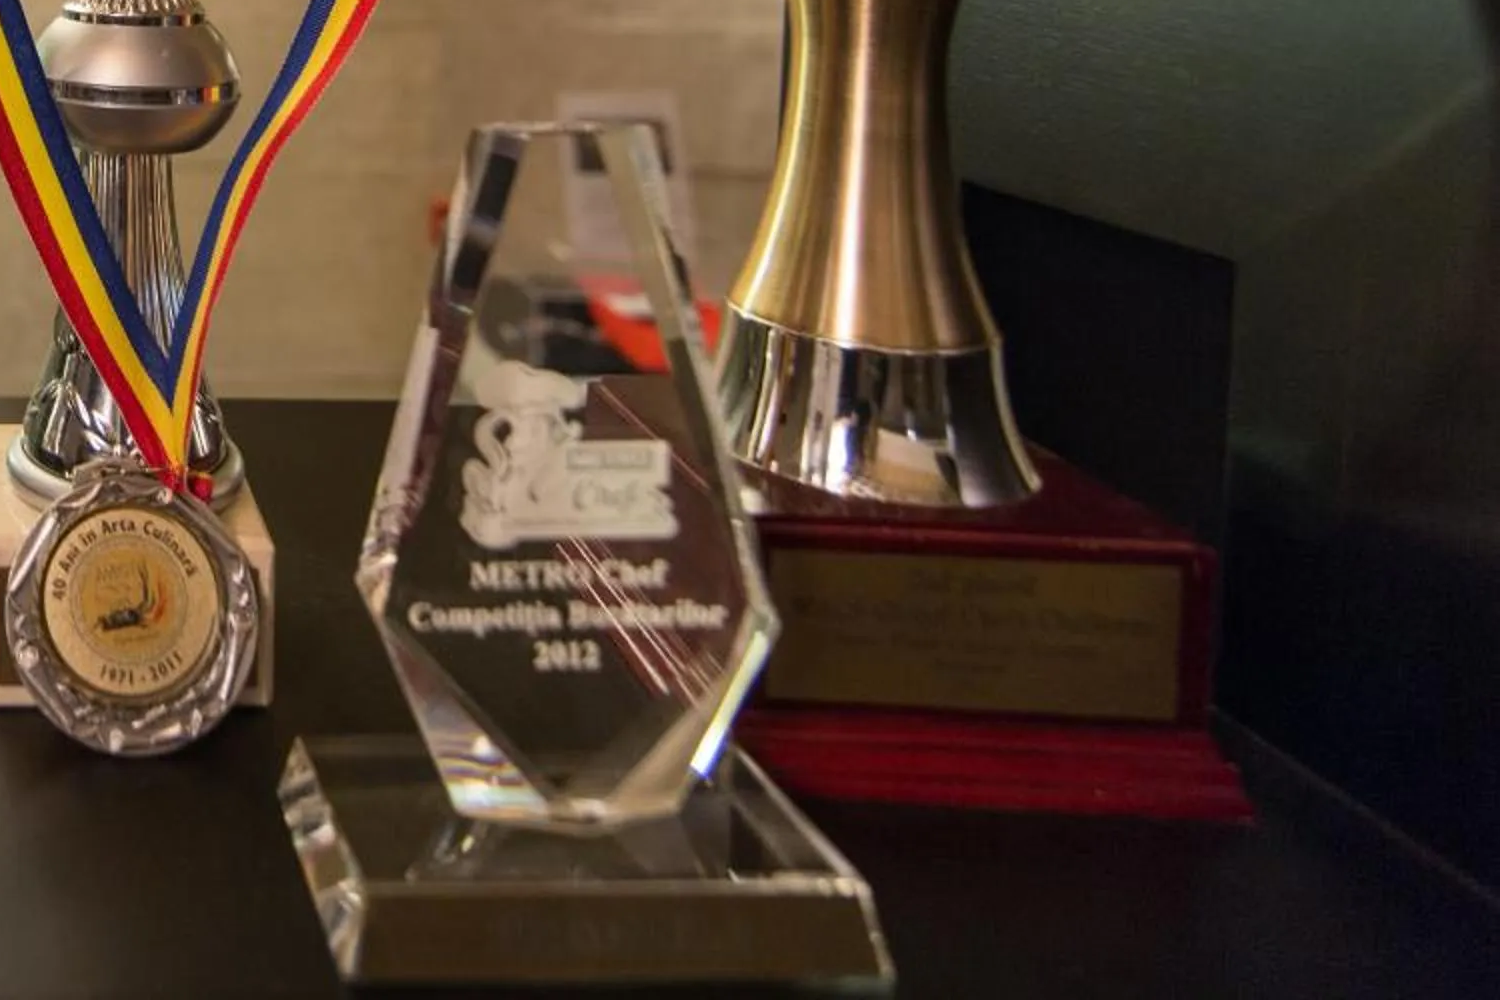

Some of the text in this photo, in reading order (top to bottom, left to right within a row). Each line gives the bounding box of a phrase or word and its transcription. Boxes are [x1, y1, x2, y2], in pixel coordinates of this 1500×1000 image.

[58, 543, 81, 574] Ani
[101, 518, 137, 535] Arta
[469, 557, 671, 591] METRO Chef
[148, 649, 184, 682] 2011
[533, 640, 602, 672] 2012
